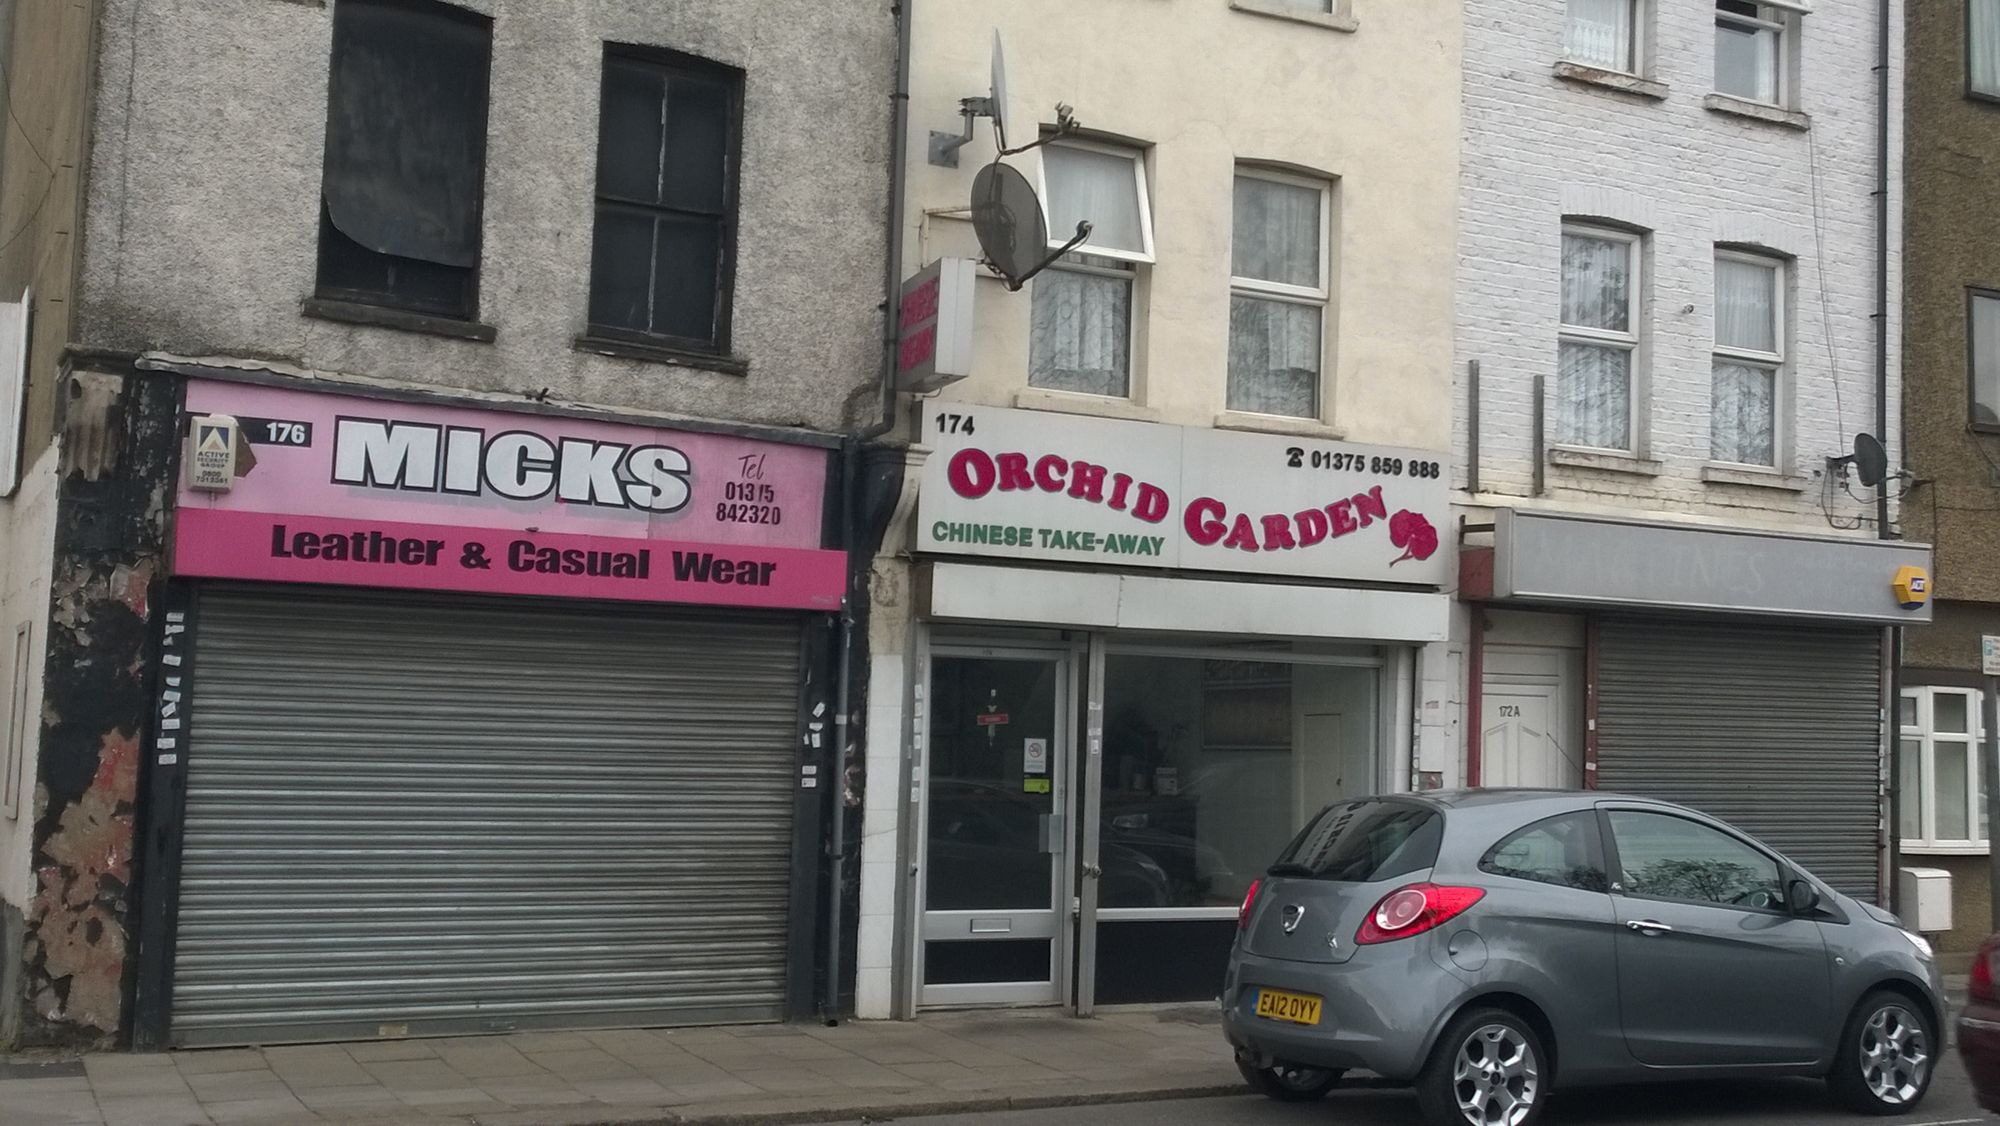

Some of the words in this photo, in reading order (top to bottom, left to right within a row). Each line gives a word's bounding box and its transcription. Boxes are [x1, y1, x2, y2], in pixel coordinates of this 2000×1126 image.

[266, 422, 305, 444] 176
[936, 413, 975, 435] 174
[331, 415, 691, 513] MICKS
[738, 454, 766, 480] Tel
[1311, 451, 1365, 473] 01375
[1371, 455, 1403, 476] 859
[1408, 459, 1440, 479] 888
[948, 448, 1170, 524] ORCHID
[1184, 485, 1388, 552] GARDEN
[716, 503, 781, 525] 842320
[932, 520, 1033, 548] CHINESE
[1038, 529, 1166, 557] TAKE-AWAY
[271, 525, 446, 566] Leather
[460, 545, 491, 571] &
[508, 540, 650, 580] Casual
[672, 551, 777, 587] Wear
[1260, 993, 1288, 1015] EA12
[1289, 998, 1317, 1020] OYY
